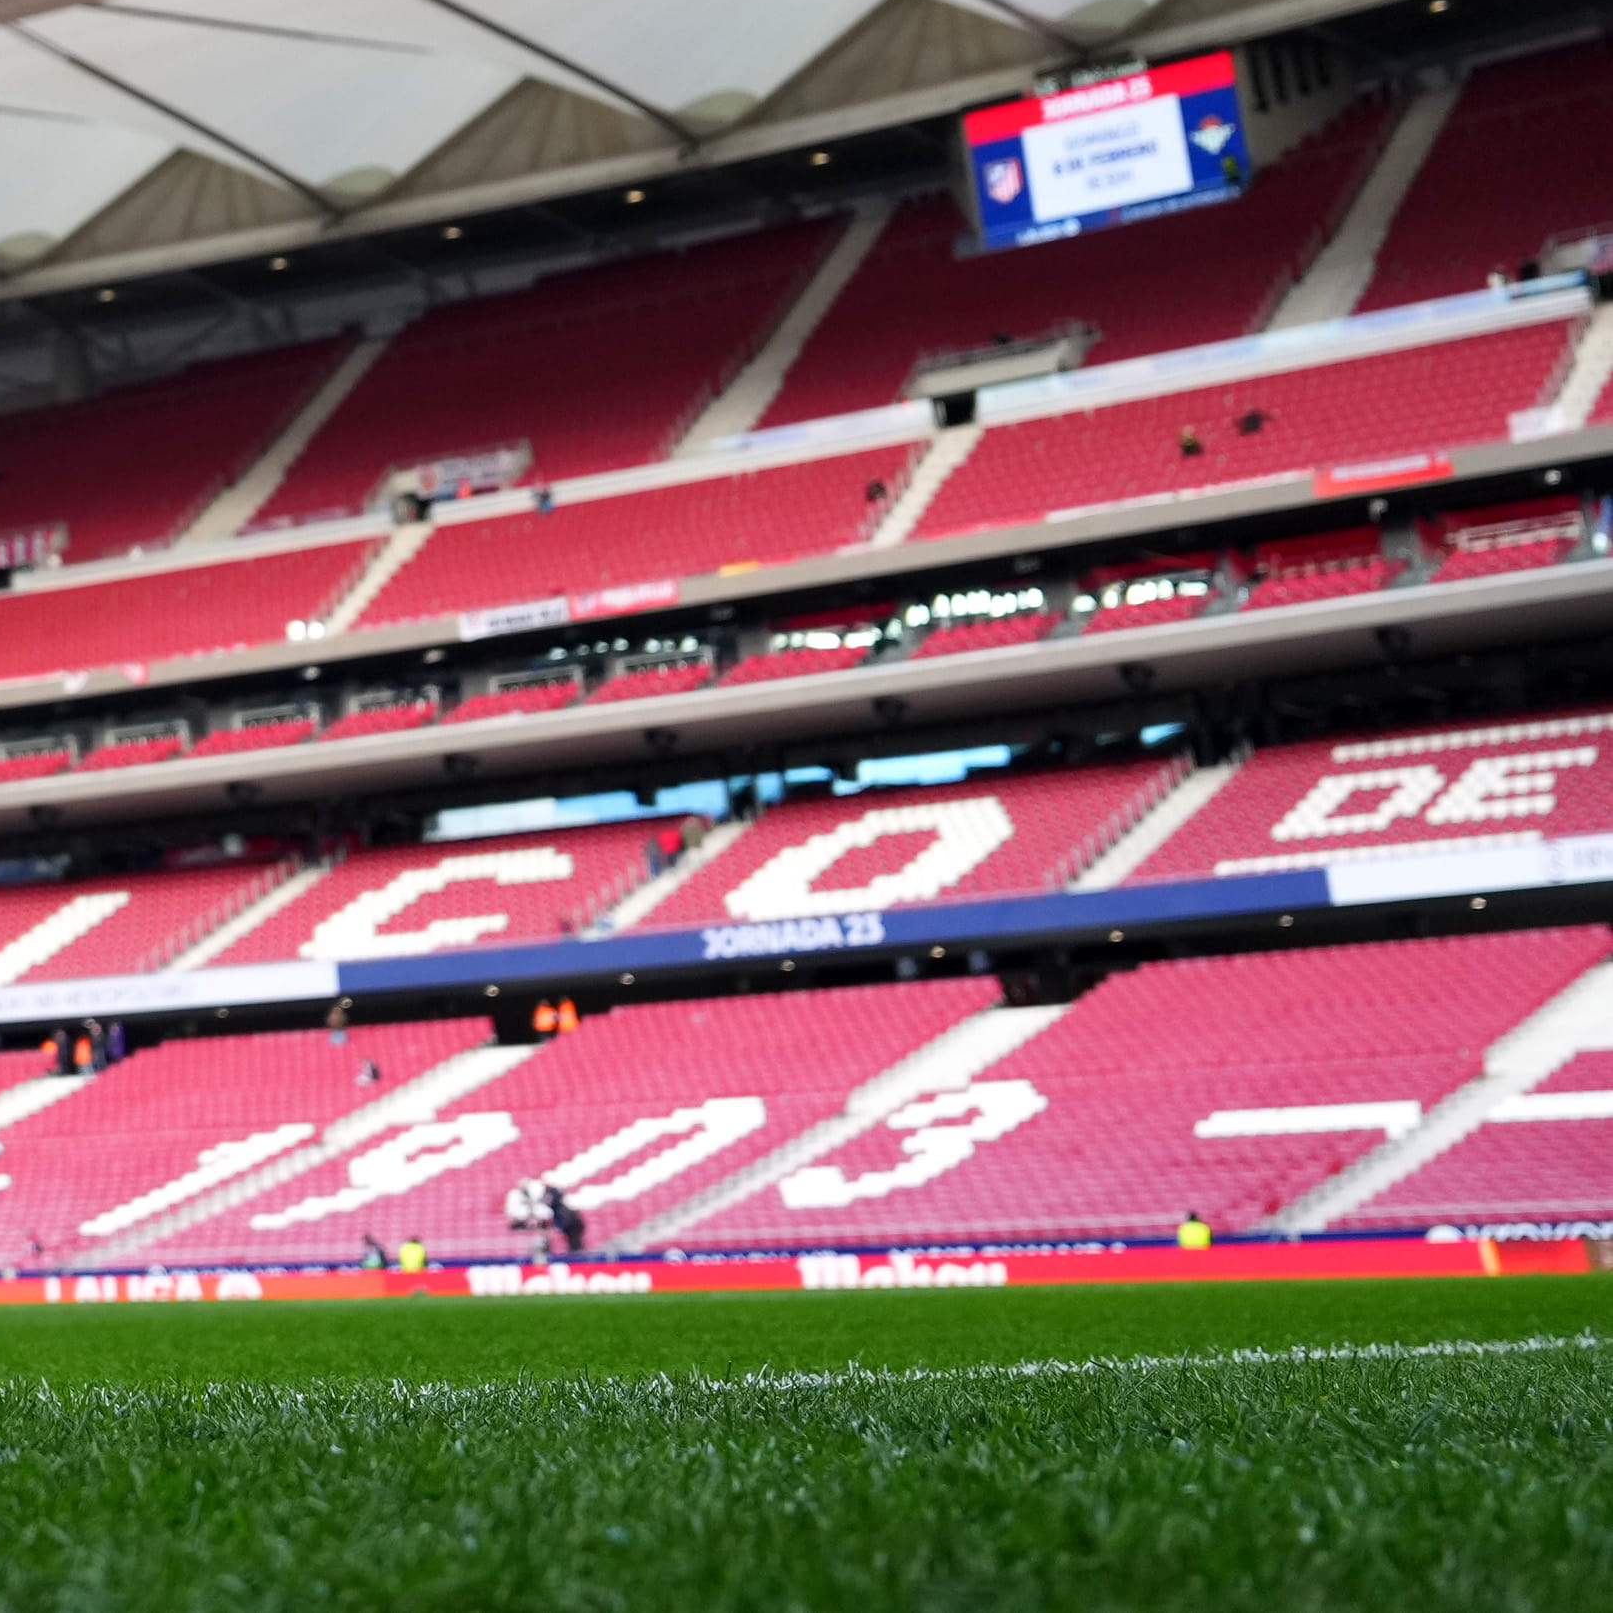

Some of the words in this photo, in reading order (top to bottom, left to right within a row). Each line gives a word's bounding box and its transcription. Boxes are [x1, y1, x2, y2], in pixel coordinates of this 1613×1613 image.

[1272, 745, 1598, 841] DE
[703, 917, 844, 959] JORNADA
[843, 912, 885, 946] 23
[466, 1263, 652, 1295] Mahou
[797, 1253, 1007, 1288] Mahou
